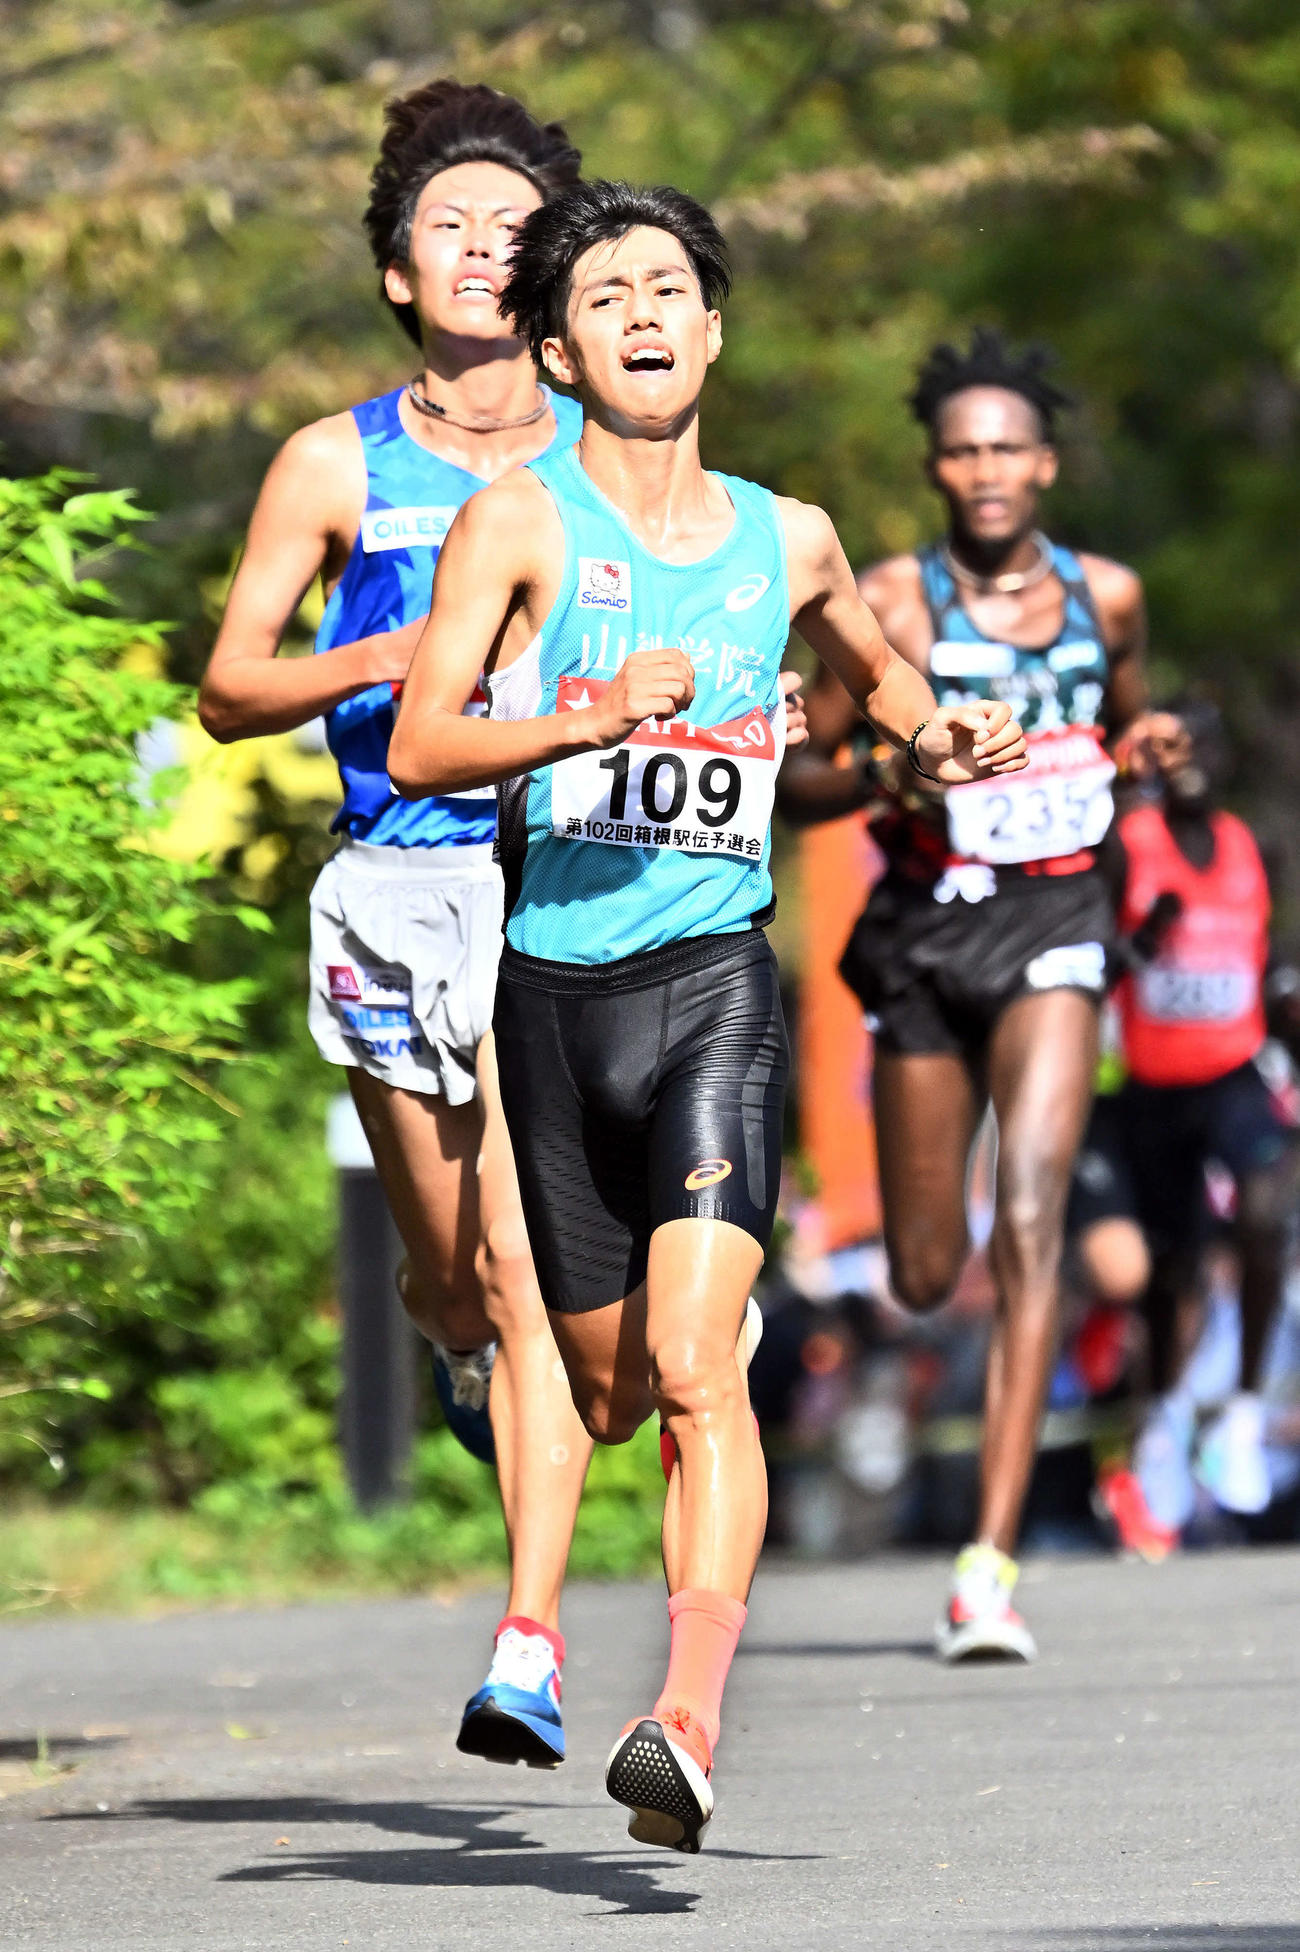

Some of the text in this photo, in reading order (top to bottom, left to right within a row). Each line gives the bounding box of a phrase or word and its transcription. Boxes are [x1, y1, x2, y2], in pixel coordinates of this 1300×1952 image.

[373, 516, 449, 539] OILES
[581, 591, 628, 609] Sanrio
[599, 748, 743, 828] 109
[985, 780, 1089, 840] 235
[565, 816, 762, 856] 第102回箱根駅伝予選会
